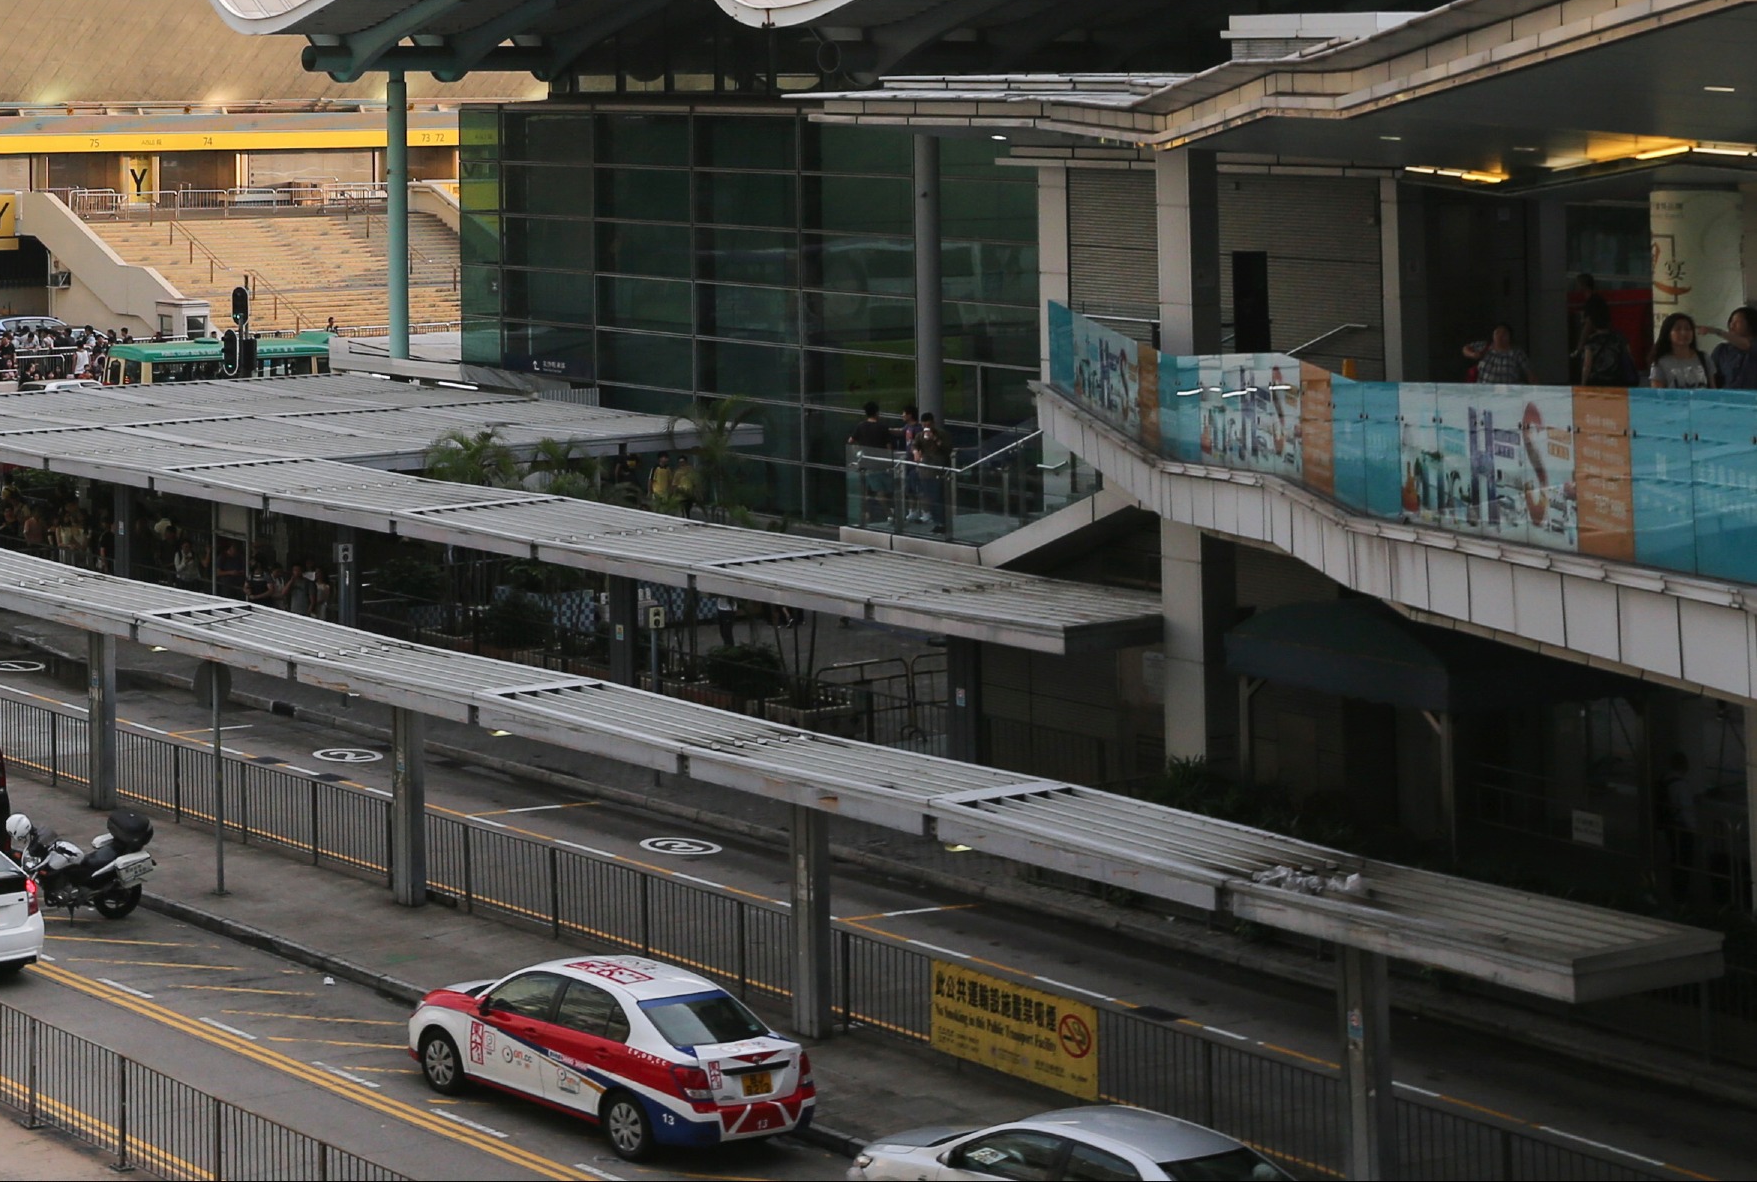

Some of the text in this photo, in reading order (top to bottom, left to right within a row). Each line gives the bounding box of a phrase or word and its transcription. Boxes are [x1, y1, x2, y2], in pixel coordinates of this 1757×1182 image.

[89, 138, 100, 148] 75
[203, 136, 213, 146] 74
[435, 133, 445, 142] 72
[130, 168, 148, 196] Y
[987, 1018, 1004, 1036] Public
[1005, 1024, 1033, 1046] Transport
[662, 1113, 675, 1126] 13
[756, 1119, 769, 1130] 13
